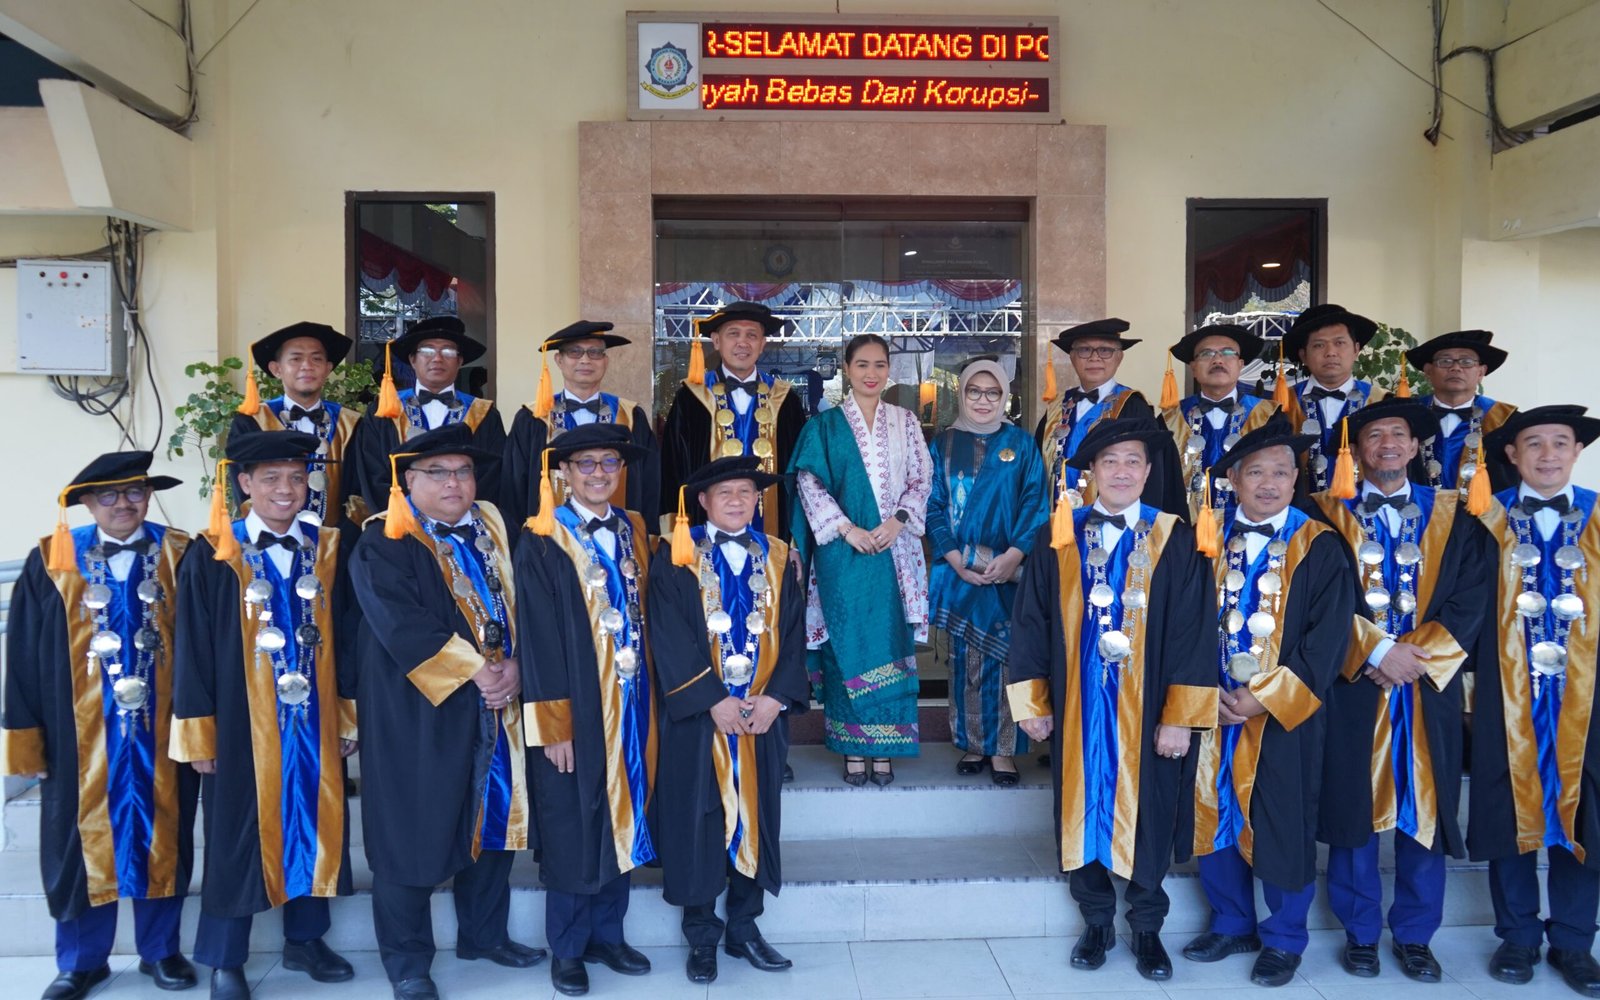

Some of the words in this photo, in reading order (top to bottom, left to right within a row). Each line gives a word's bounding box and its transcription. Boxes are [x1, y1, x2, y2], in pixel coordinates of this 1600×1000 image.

[863, 32, 972, 58] DATANG
[982, 34, 1006, 59] DI
[765, 78, 852, 104] Bebas
[861, 79, 917, 104] Dari
[923, 80, 1039, 109] Korupsi-
